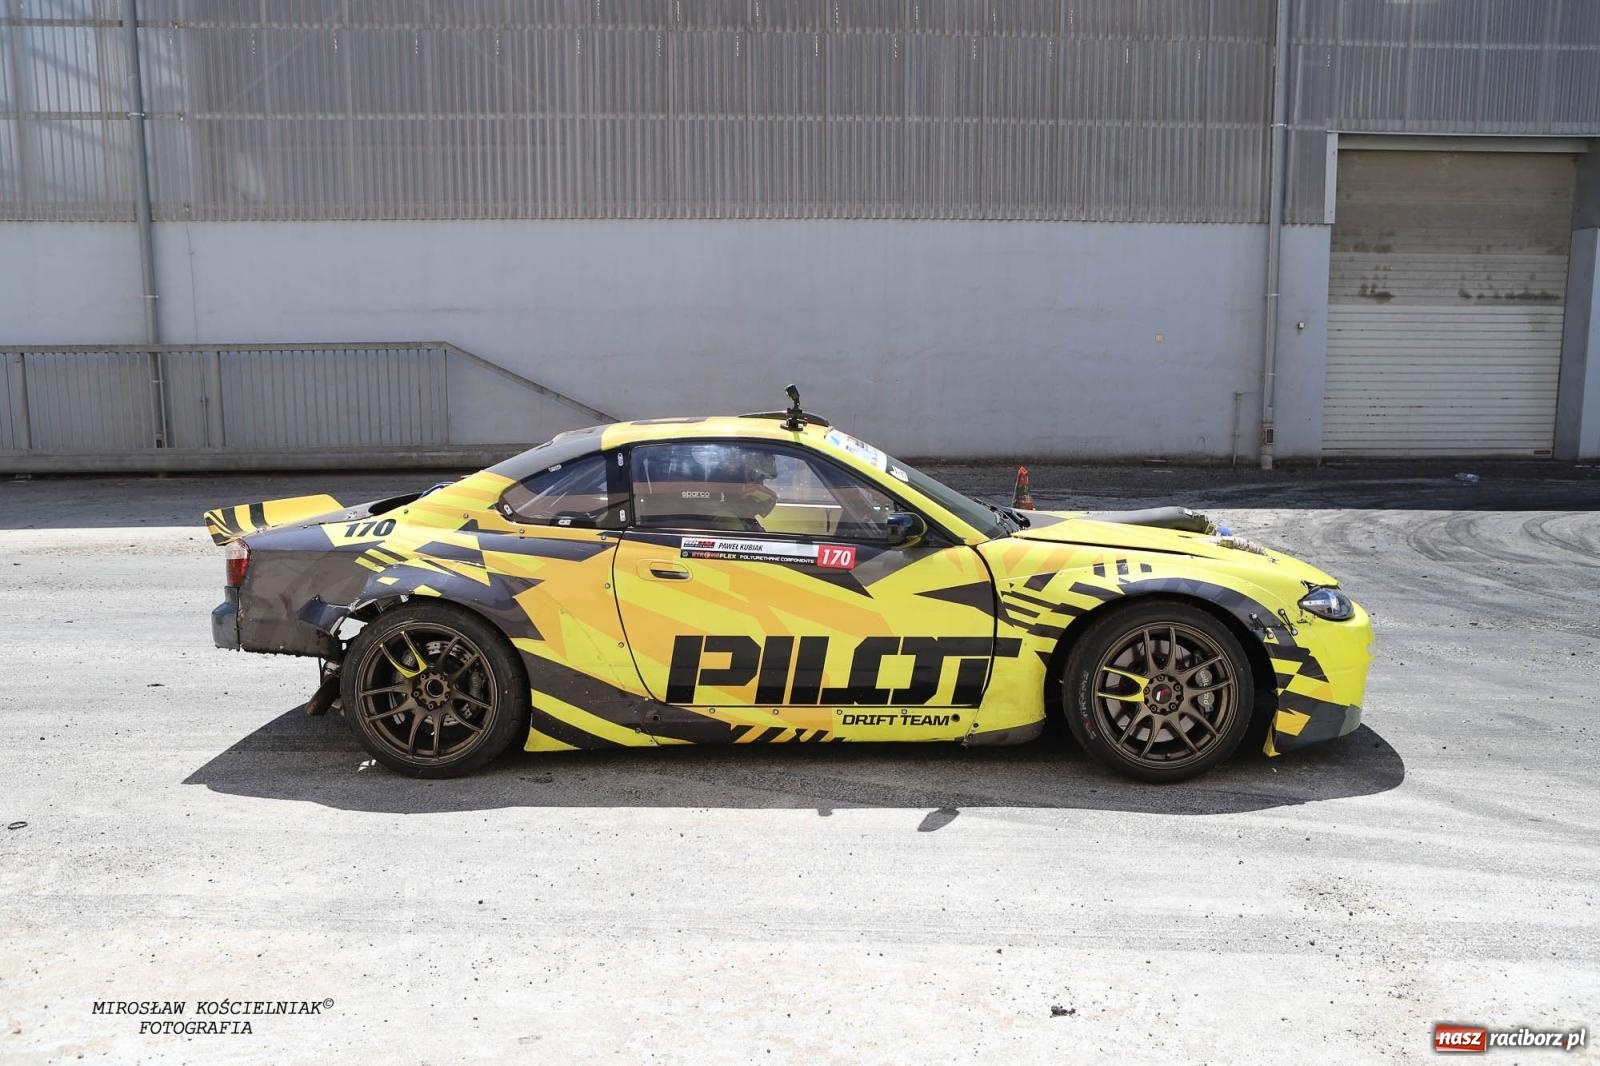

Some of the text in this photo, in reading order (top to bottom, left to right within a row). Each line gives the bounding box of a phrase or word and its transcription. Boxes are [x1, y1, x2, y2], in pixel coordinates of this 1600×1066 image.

[344, 518, 397, 538] 170
[740, 543, 763, 552] KUBIAK
[822, 549, 851, 566] 170
[665, 635, 1023, 706] PILOT
[842, 713, 950, 726] DRIFT TEAM
